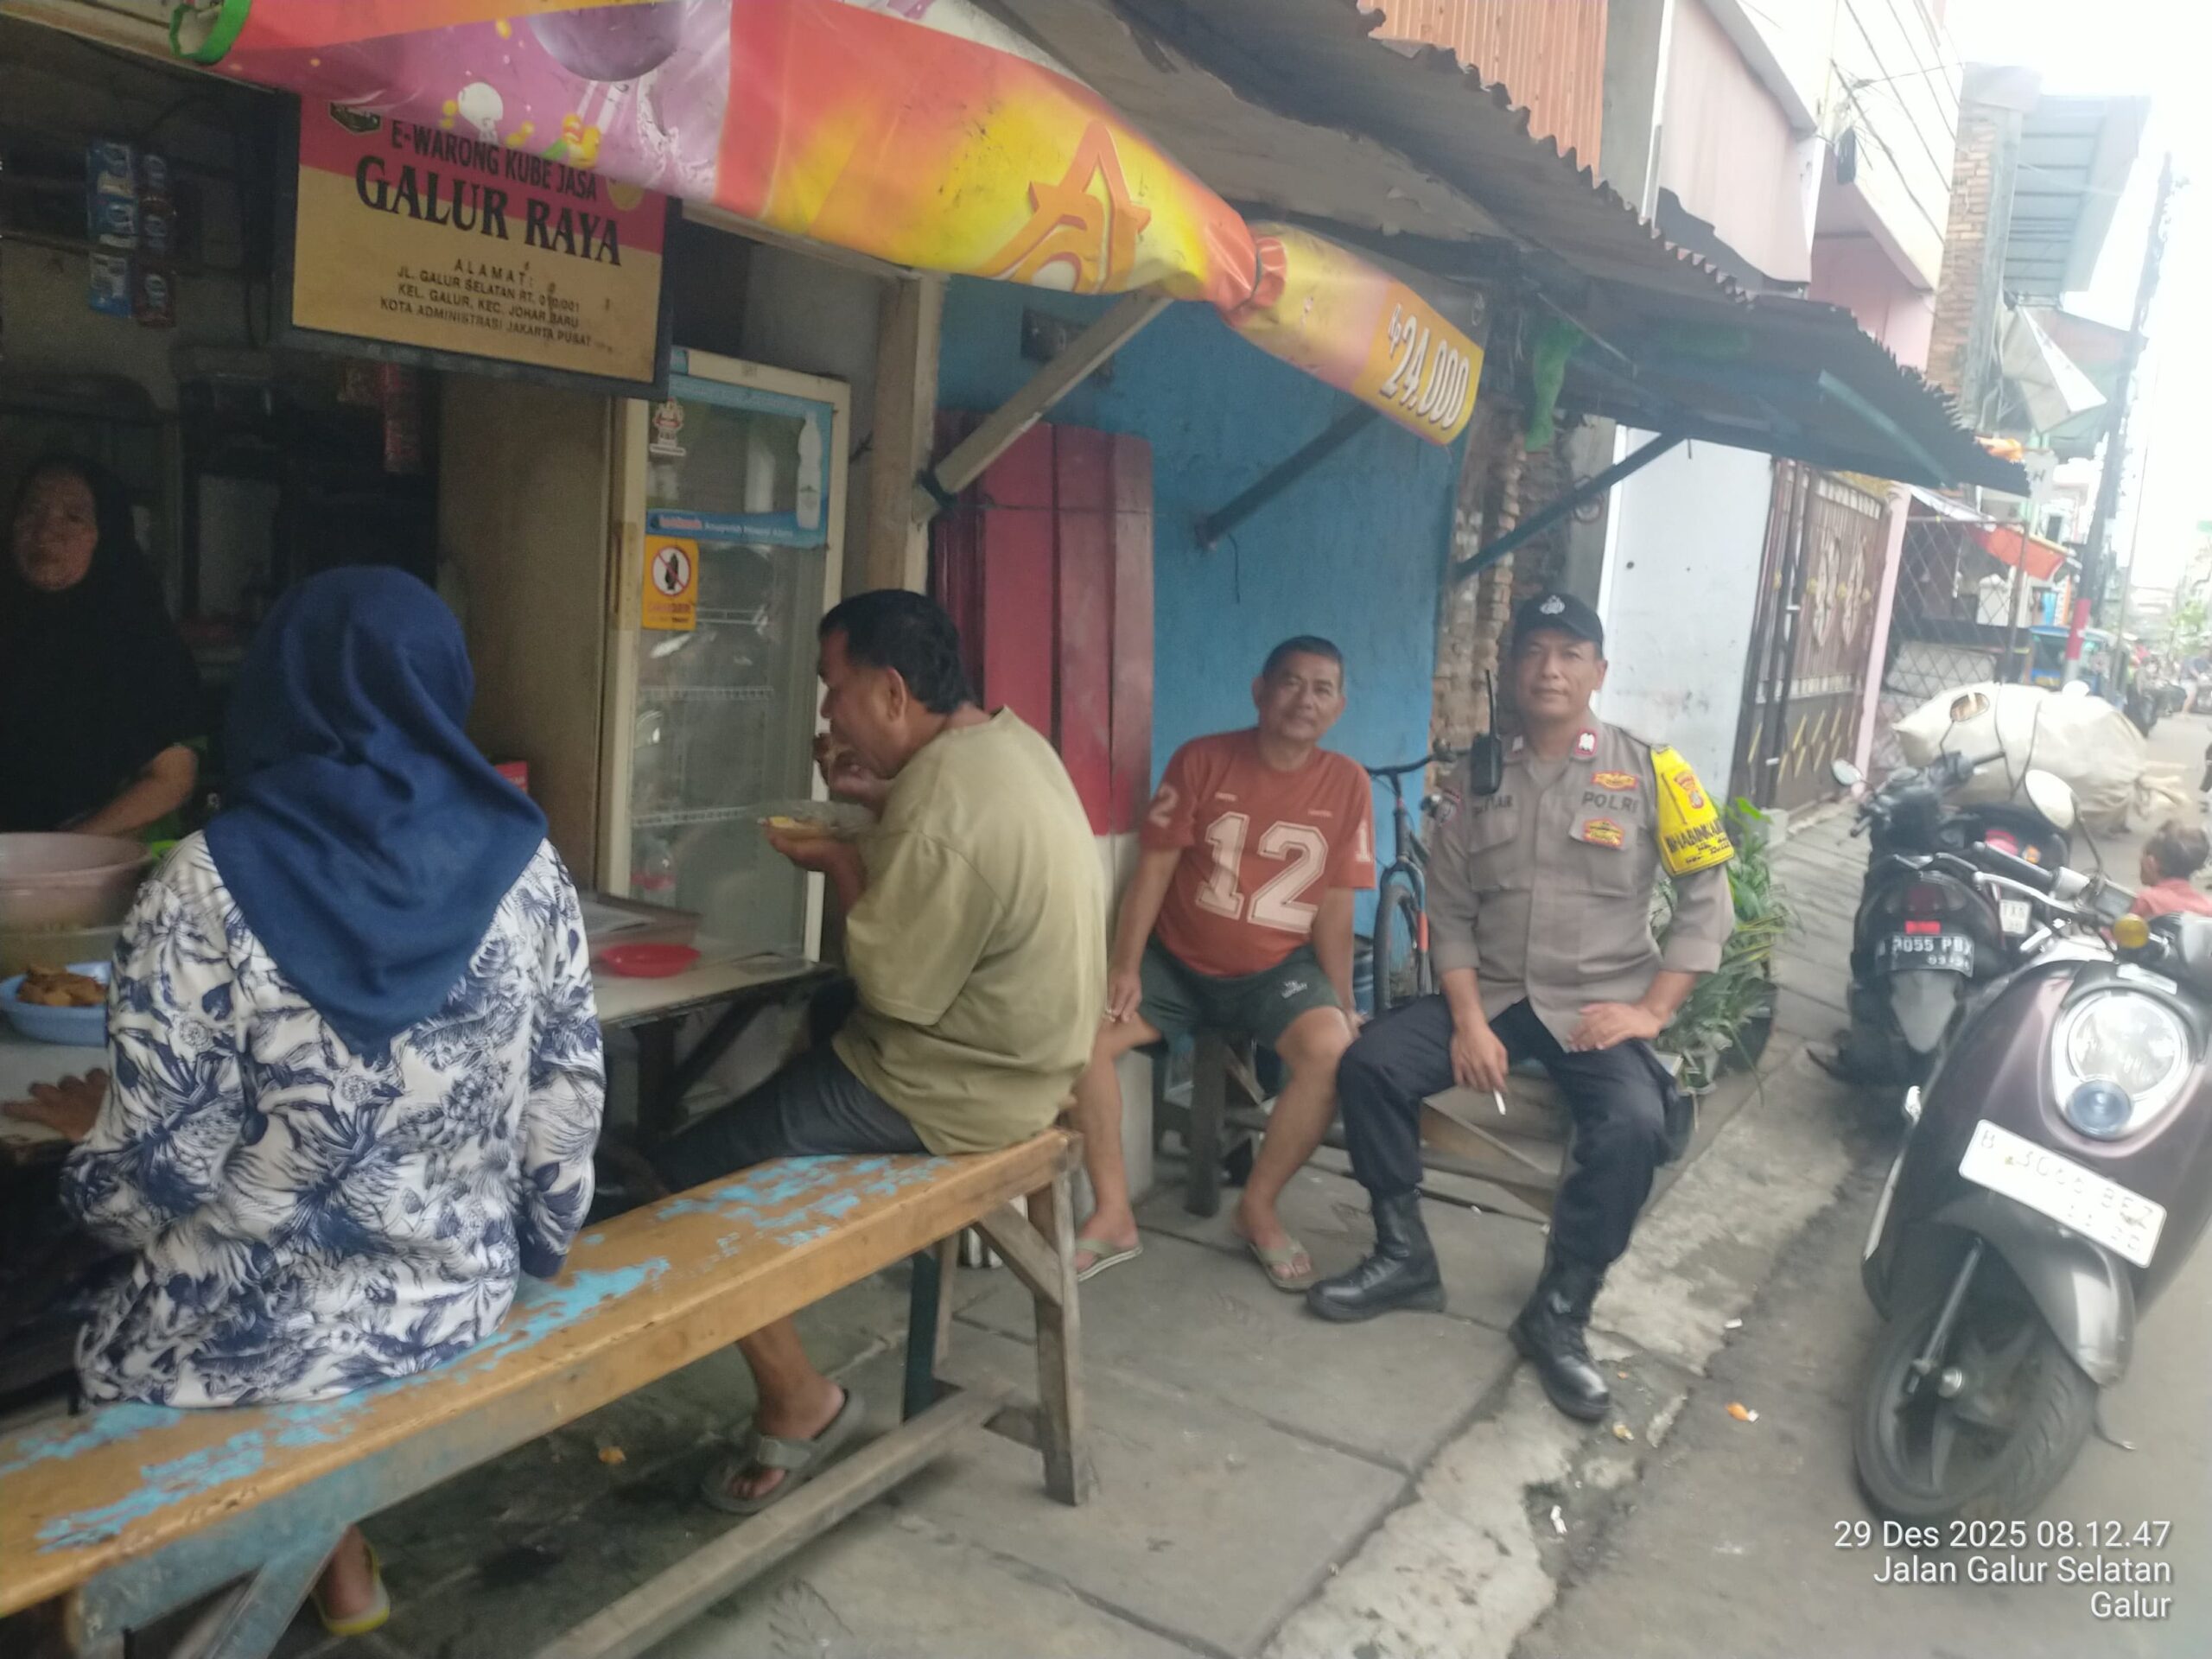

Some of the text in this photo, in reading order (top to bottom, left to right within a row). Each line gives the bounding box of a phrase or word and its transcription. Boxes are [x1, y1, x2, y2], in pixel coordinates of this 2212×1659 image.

[391, 119, 597, 201] E-WARONG KUBE JASA
[356, 155, 622, 267] GALUR RAYA
[420, 270, 461, 289] GALUR
[465, 277, 515, 299] SELATAN
[380, 296, 591, 346] KOTA ADMINISTRASI JAKARTA PUSAT
[509, 304, 546, 321] JOHAR
[550, 310, 578, 328] BARU
[1580, 791, 1640, 814] POLRI
[1194, 810, 1329, 935] 12
